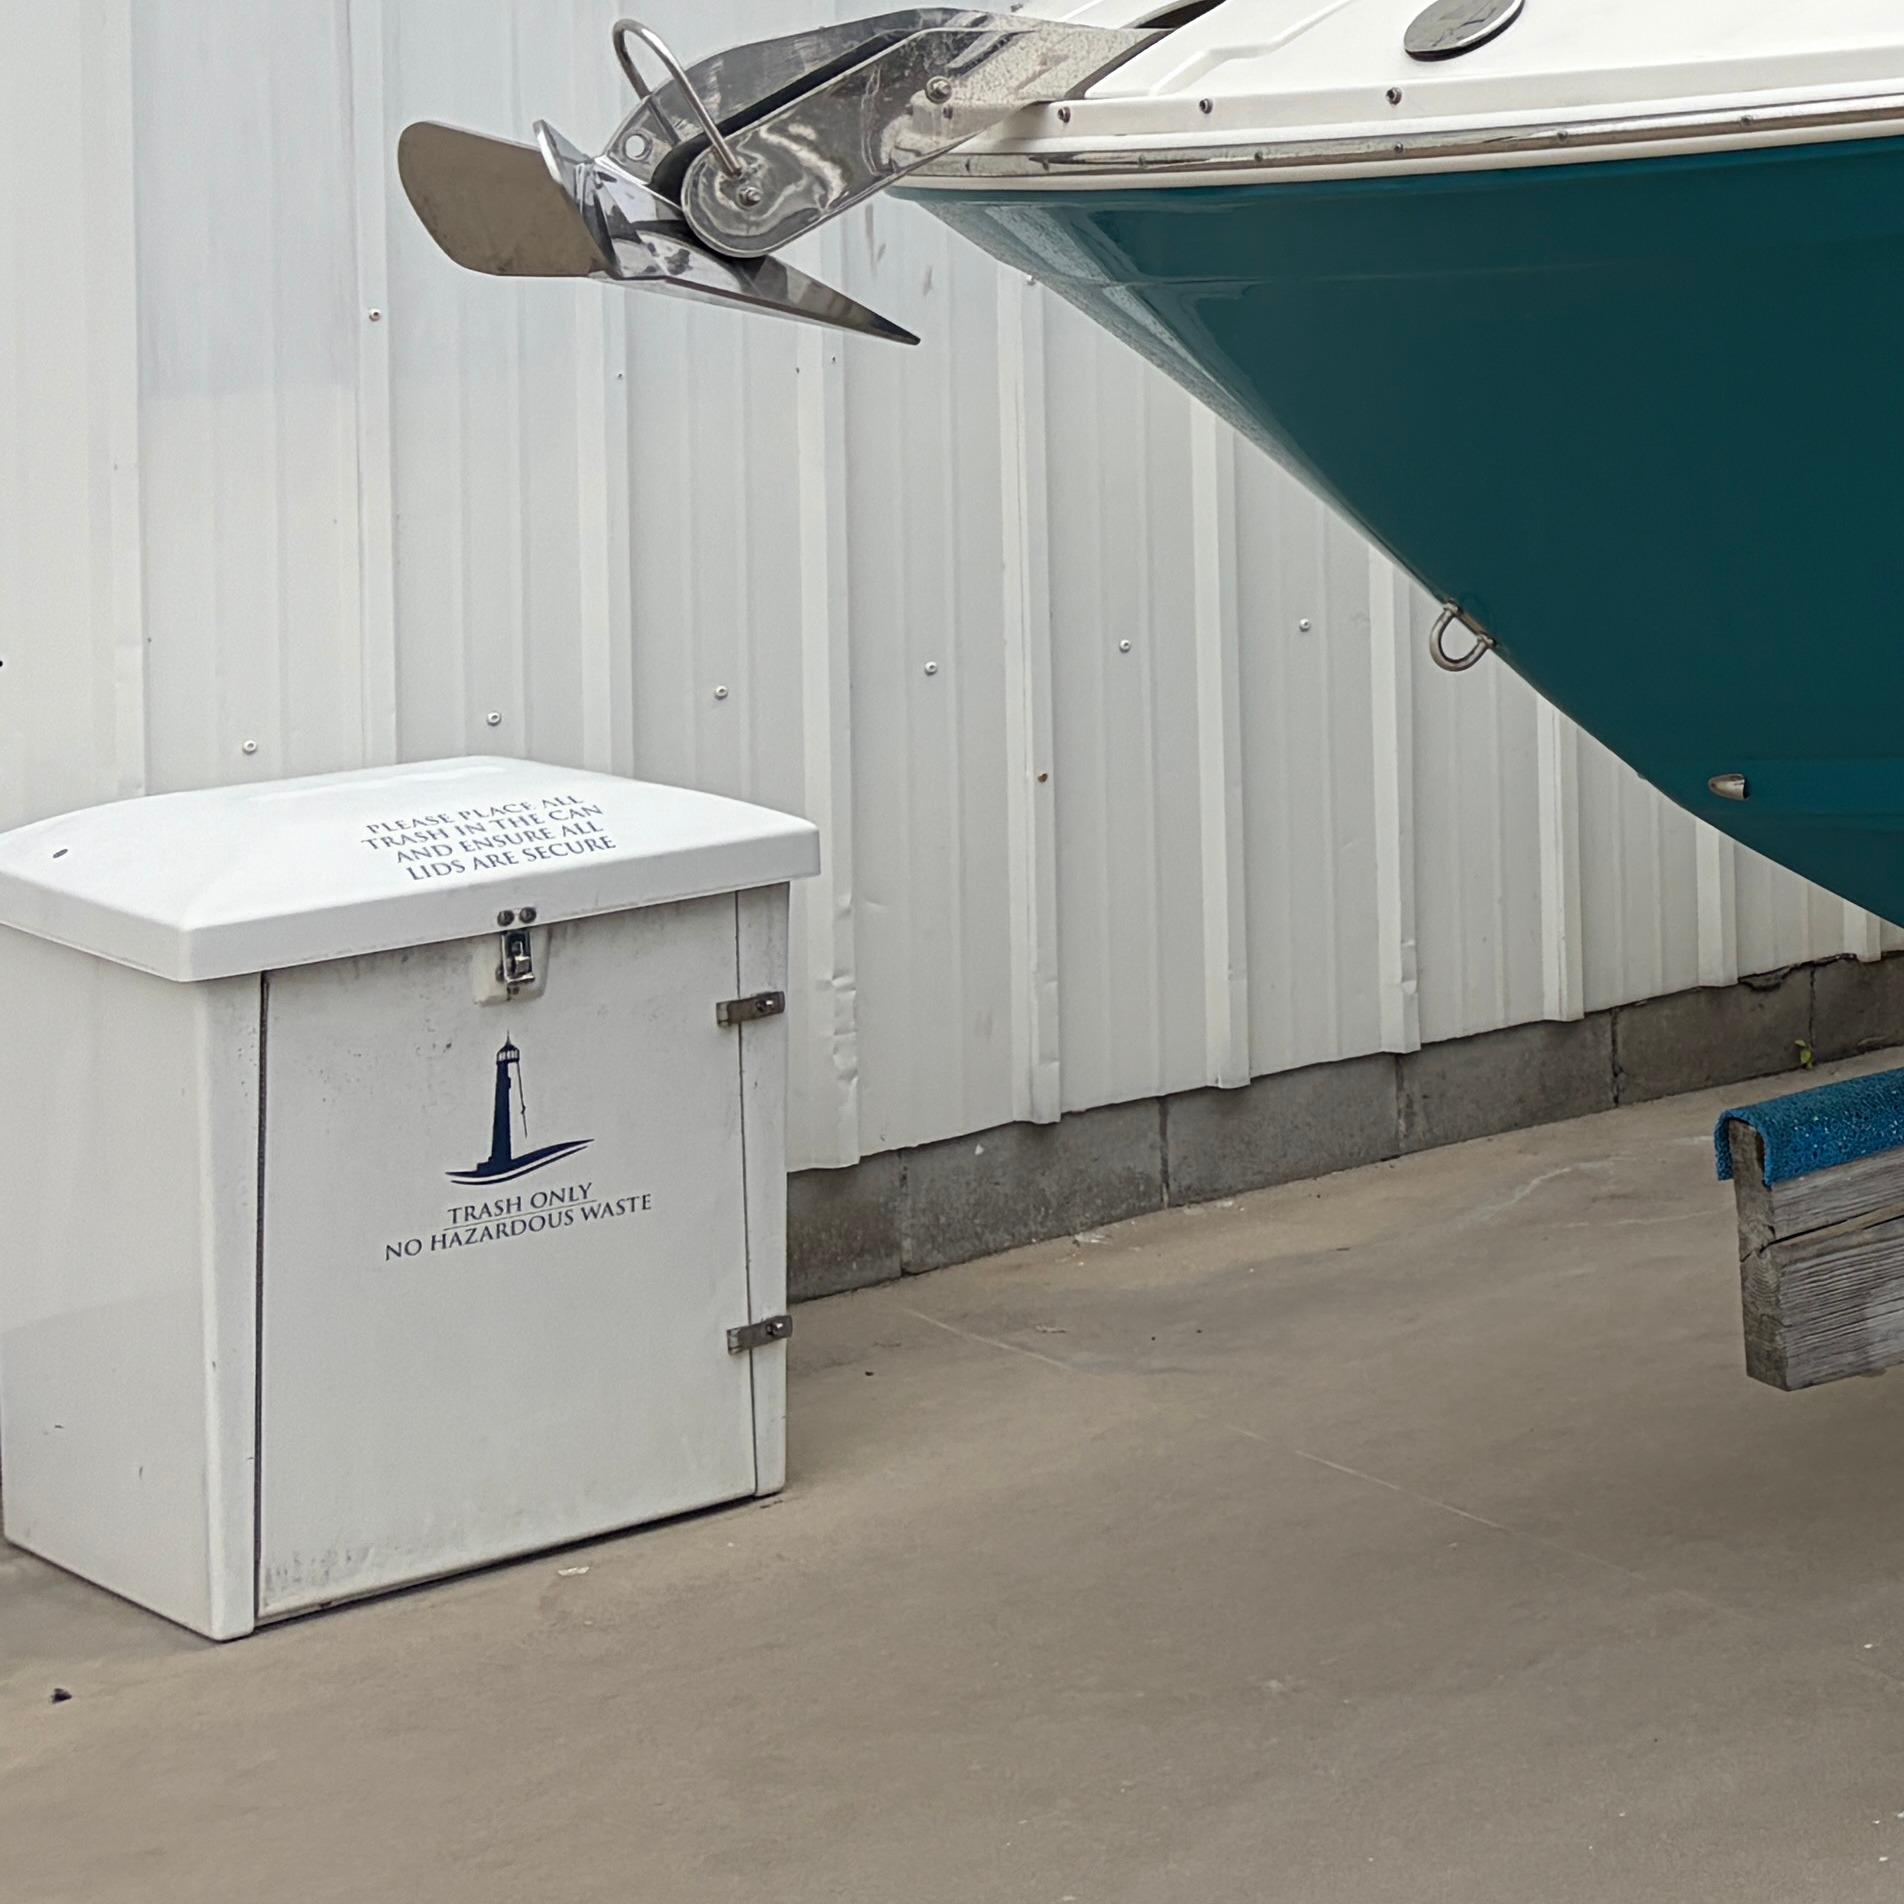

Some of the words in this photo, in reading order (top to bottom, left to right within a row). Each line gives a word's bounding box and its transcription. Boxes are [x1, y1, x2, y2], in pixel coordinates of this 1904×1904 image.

[361, 827, 450, 850] TRASH
[455, 822, 485, 836] IN
[490, 813, 546, 831] THE
[547, 804, 603, 821] CAN
[366, 811, 455, 834] PLEASE
[458, 801, 536, 821] PLACE
[541, 795, 585, 809] ALL
[397, 844, 453, 864] AND
[458, 827, 558, 853] ENSURE
[561, 820, 604, 838] ALL
[405, 859, 466, 881] LIDS
[473, 850, 520, 871] ARE
[521, 835, 617, 862] SECURE
[447, 1196, 522, 1225] TRASH
[530, 1182, 593, 1209] ONLY
[385, 1238, 423, 1261] NO
[430, 1209, 574, 1251] HAZARDOUS
[581, 1193, 652, 1222] WASTE
